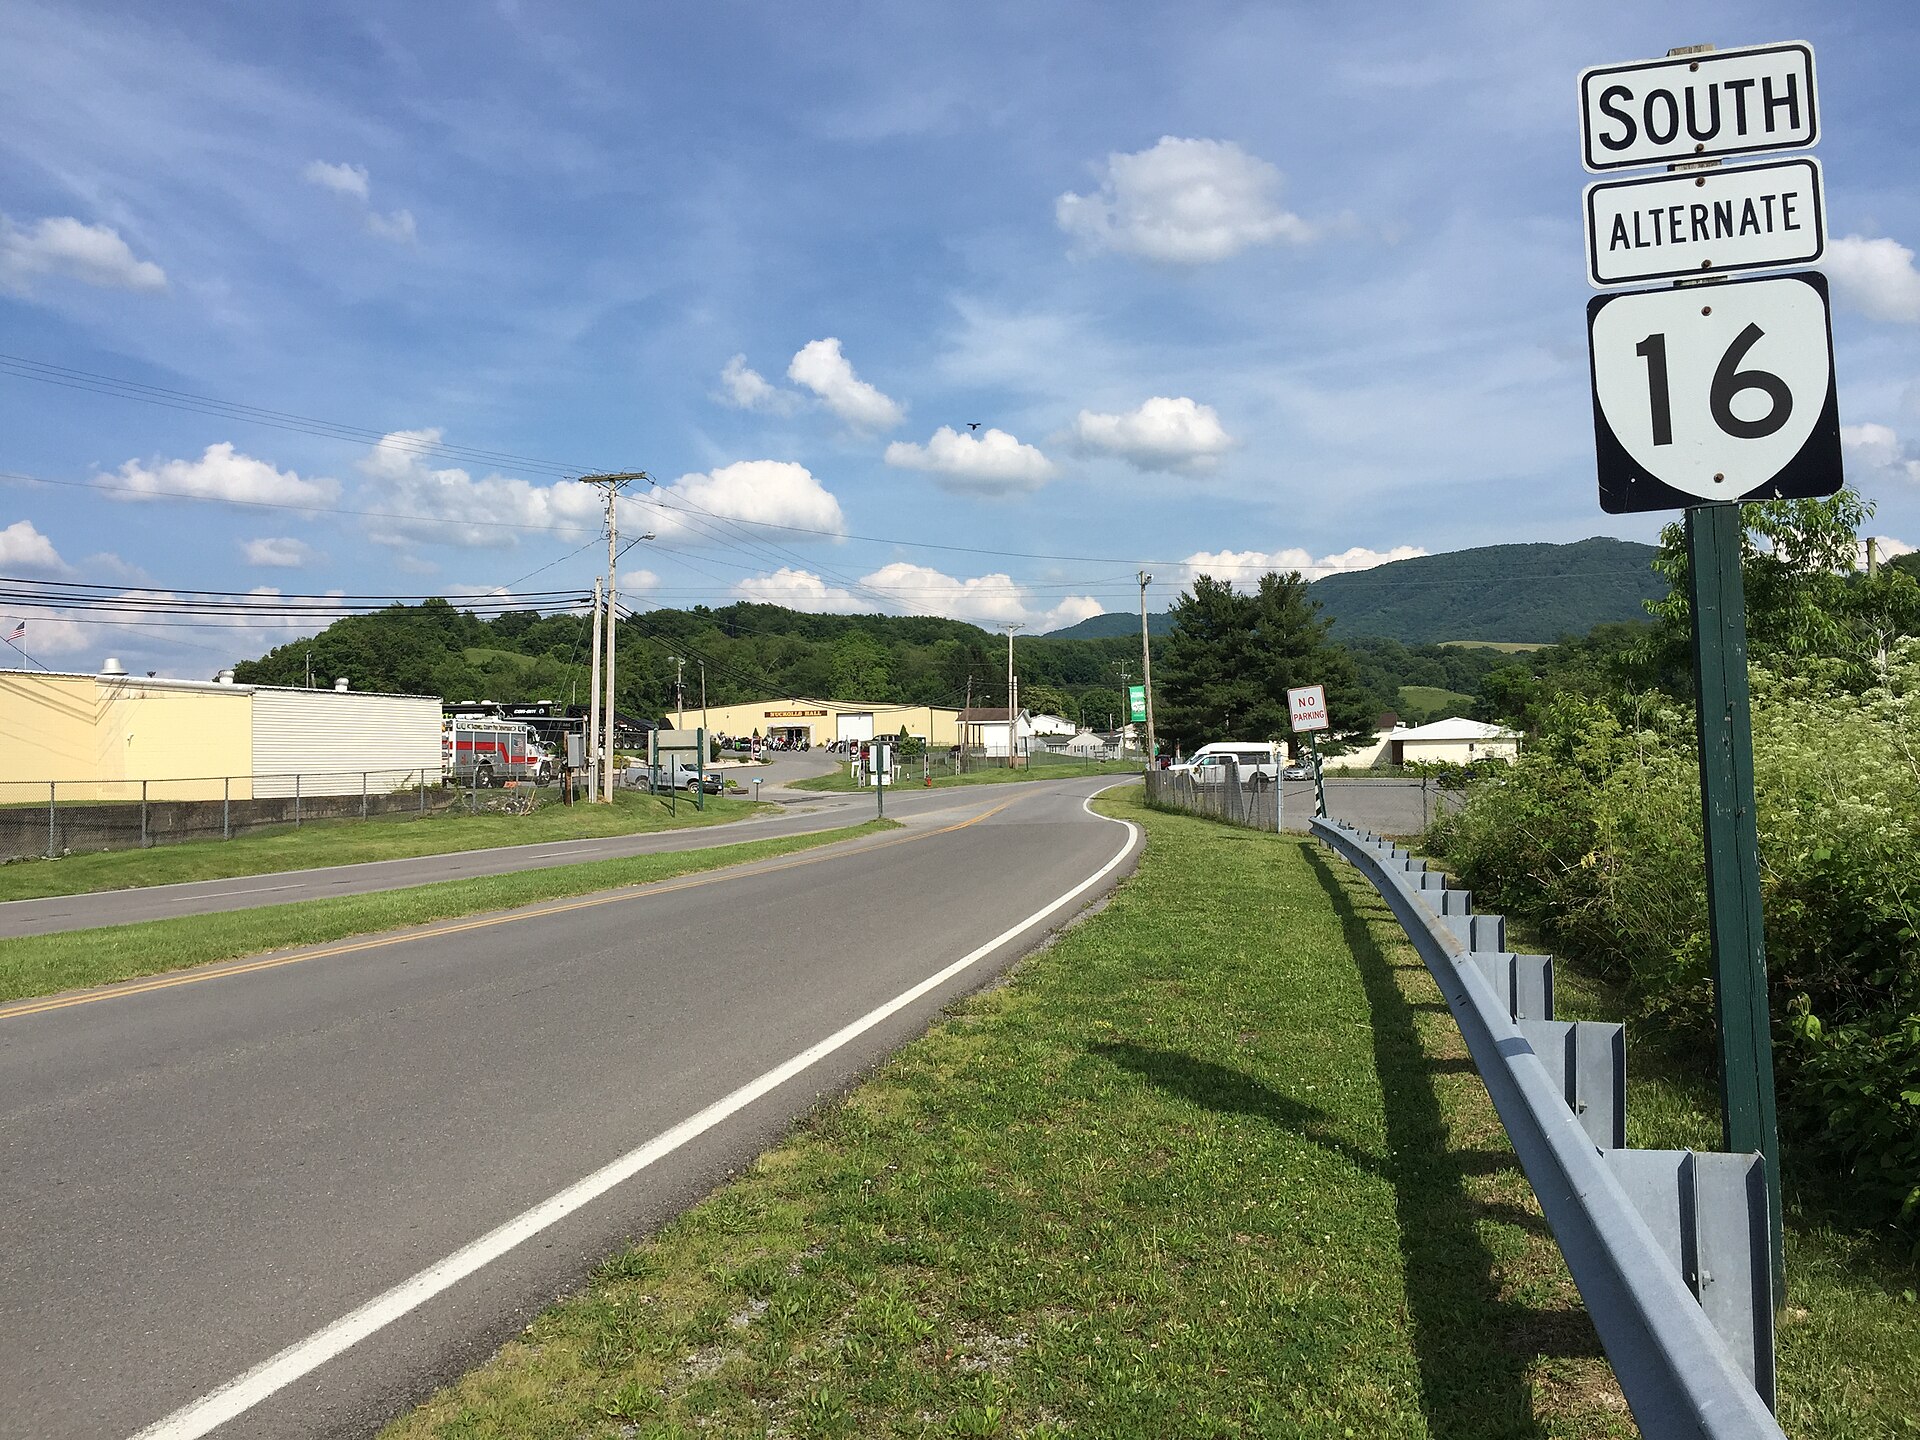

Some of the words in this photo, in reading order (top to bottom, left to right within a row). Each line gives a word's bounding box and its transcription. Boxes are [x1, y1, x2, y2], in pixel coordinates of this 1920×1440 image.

[1598, 73, 1801, 151] SOUTH
[1609, 192, 1801, 251] ALTERNATE
[1636, 322, 1793, 446] 16
[1293, 710, 1324, 721] PARKING
[1298, 696, 1315, 707] NO
